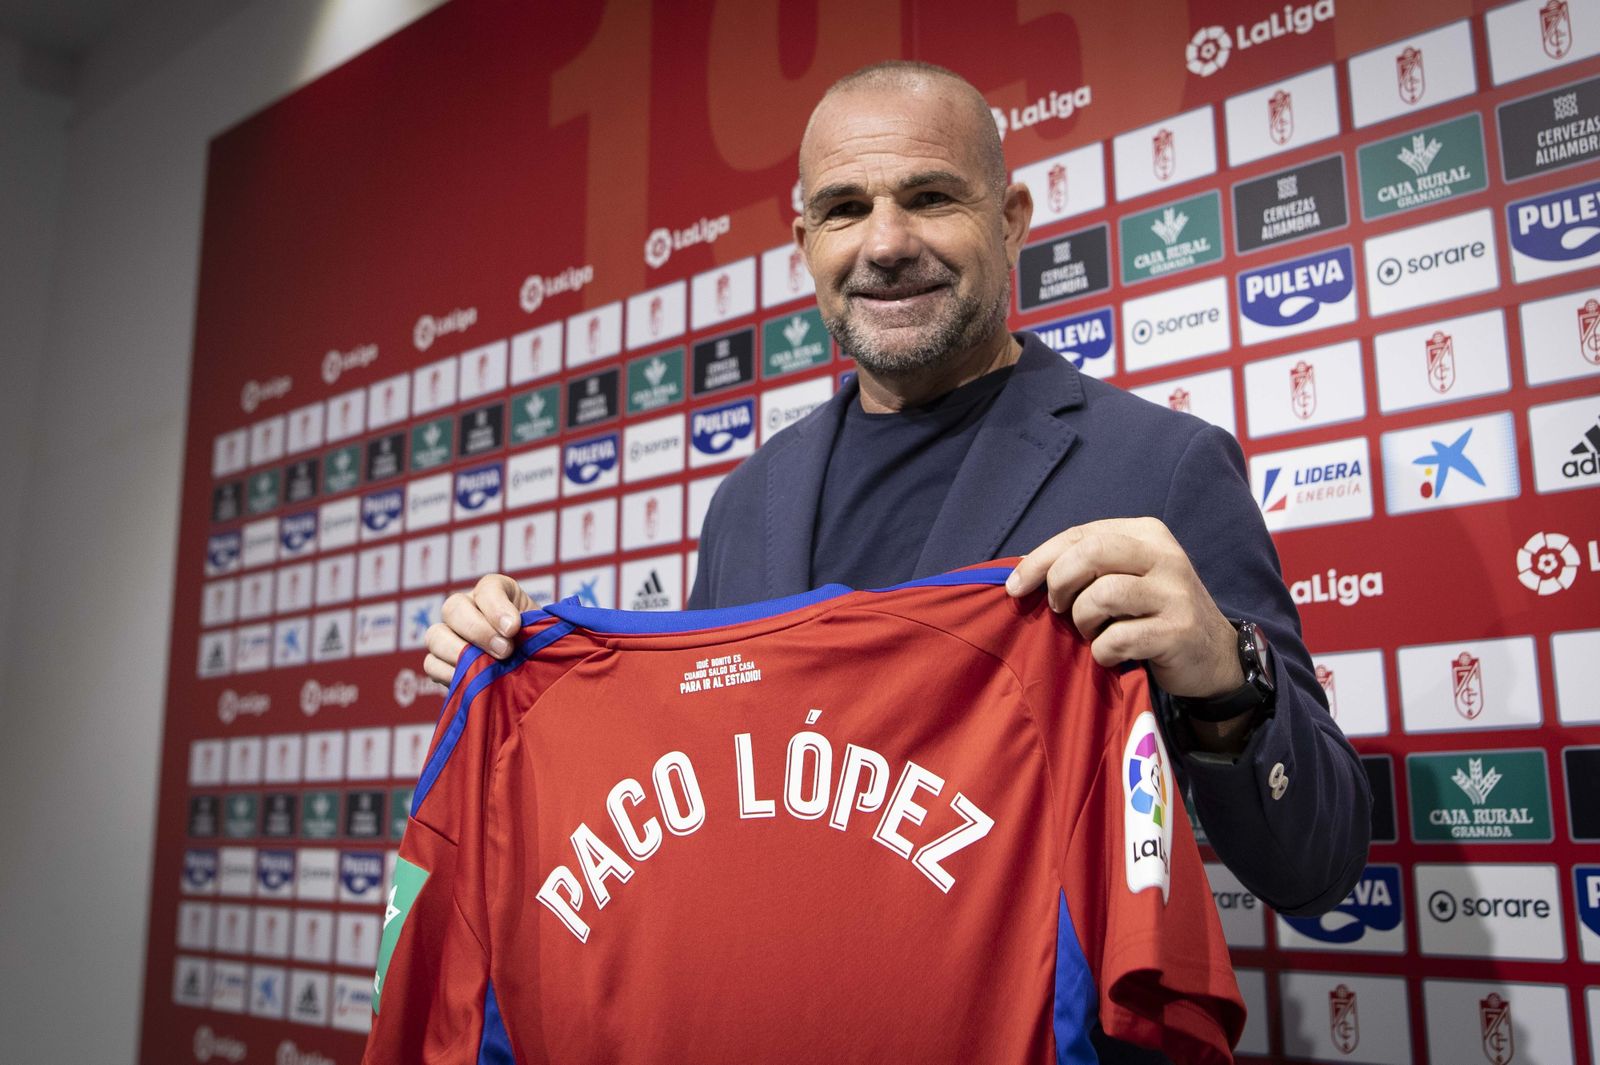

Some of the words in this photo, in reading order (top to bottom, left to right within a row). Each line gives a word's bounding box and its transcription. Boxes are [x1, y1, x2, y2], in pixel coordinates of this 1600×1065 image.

[1236, 0, 1335, 50] LaLiga
[1010, 85, 1093, 131] LaLiga
[1535, 134, 1600, 166] ALHAMBR
[1377, 181, 1413, 202] CAJA
[1417, 165, 1471, 189] RURAL
[1396, 187, 1452, 208] GRANADA
[1263, 196, 1316, 224] CERVEZAS
[1518, 192, 1600, 235] PULE
[1261, 212, 1321, 241] ALHAMBRA
[1406, 241, 1486, 274] sorare
[1245, 259, 1344, 303] PULEVA
[1038, 318, 1106, 350] ULEVA
[1157, 307, 1220, 336] sorare
[1294, 459, 1362, 486] LIDERA
[1296, 478, 1362, 505] ENERGÍA
[1290, 569, 1384, 606] aLiga
[684, 670, 706, 680] CUANDO
[708, 666, 727, 676] SALGO
[729, 664, 737, 672] DE
[739, 661, 754, 671] CASA
[711, 656, 731, 666] BONITO
[733, 654, 741, 663] ES
[680, 680, 701, 693] PARA
[703, 678, 711, 689] IR
[713, 676, 723, 687] AL
[535, 750, 706, 944] PACO
[734, 709, 995, 894] LÓPEZ
[1429, 809, 1471, 825] CAJA
[1473, 808, 1534, 825] RURAL
[1451, 826, 1513, 838] GRANADA
[1462, 897, 1551, 919] sorare
